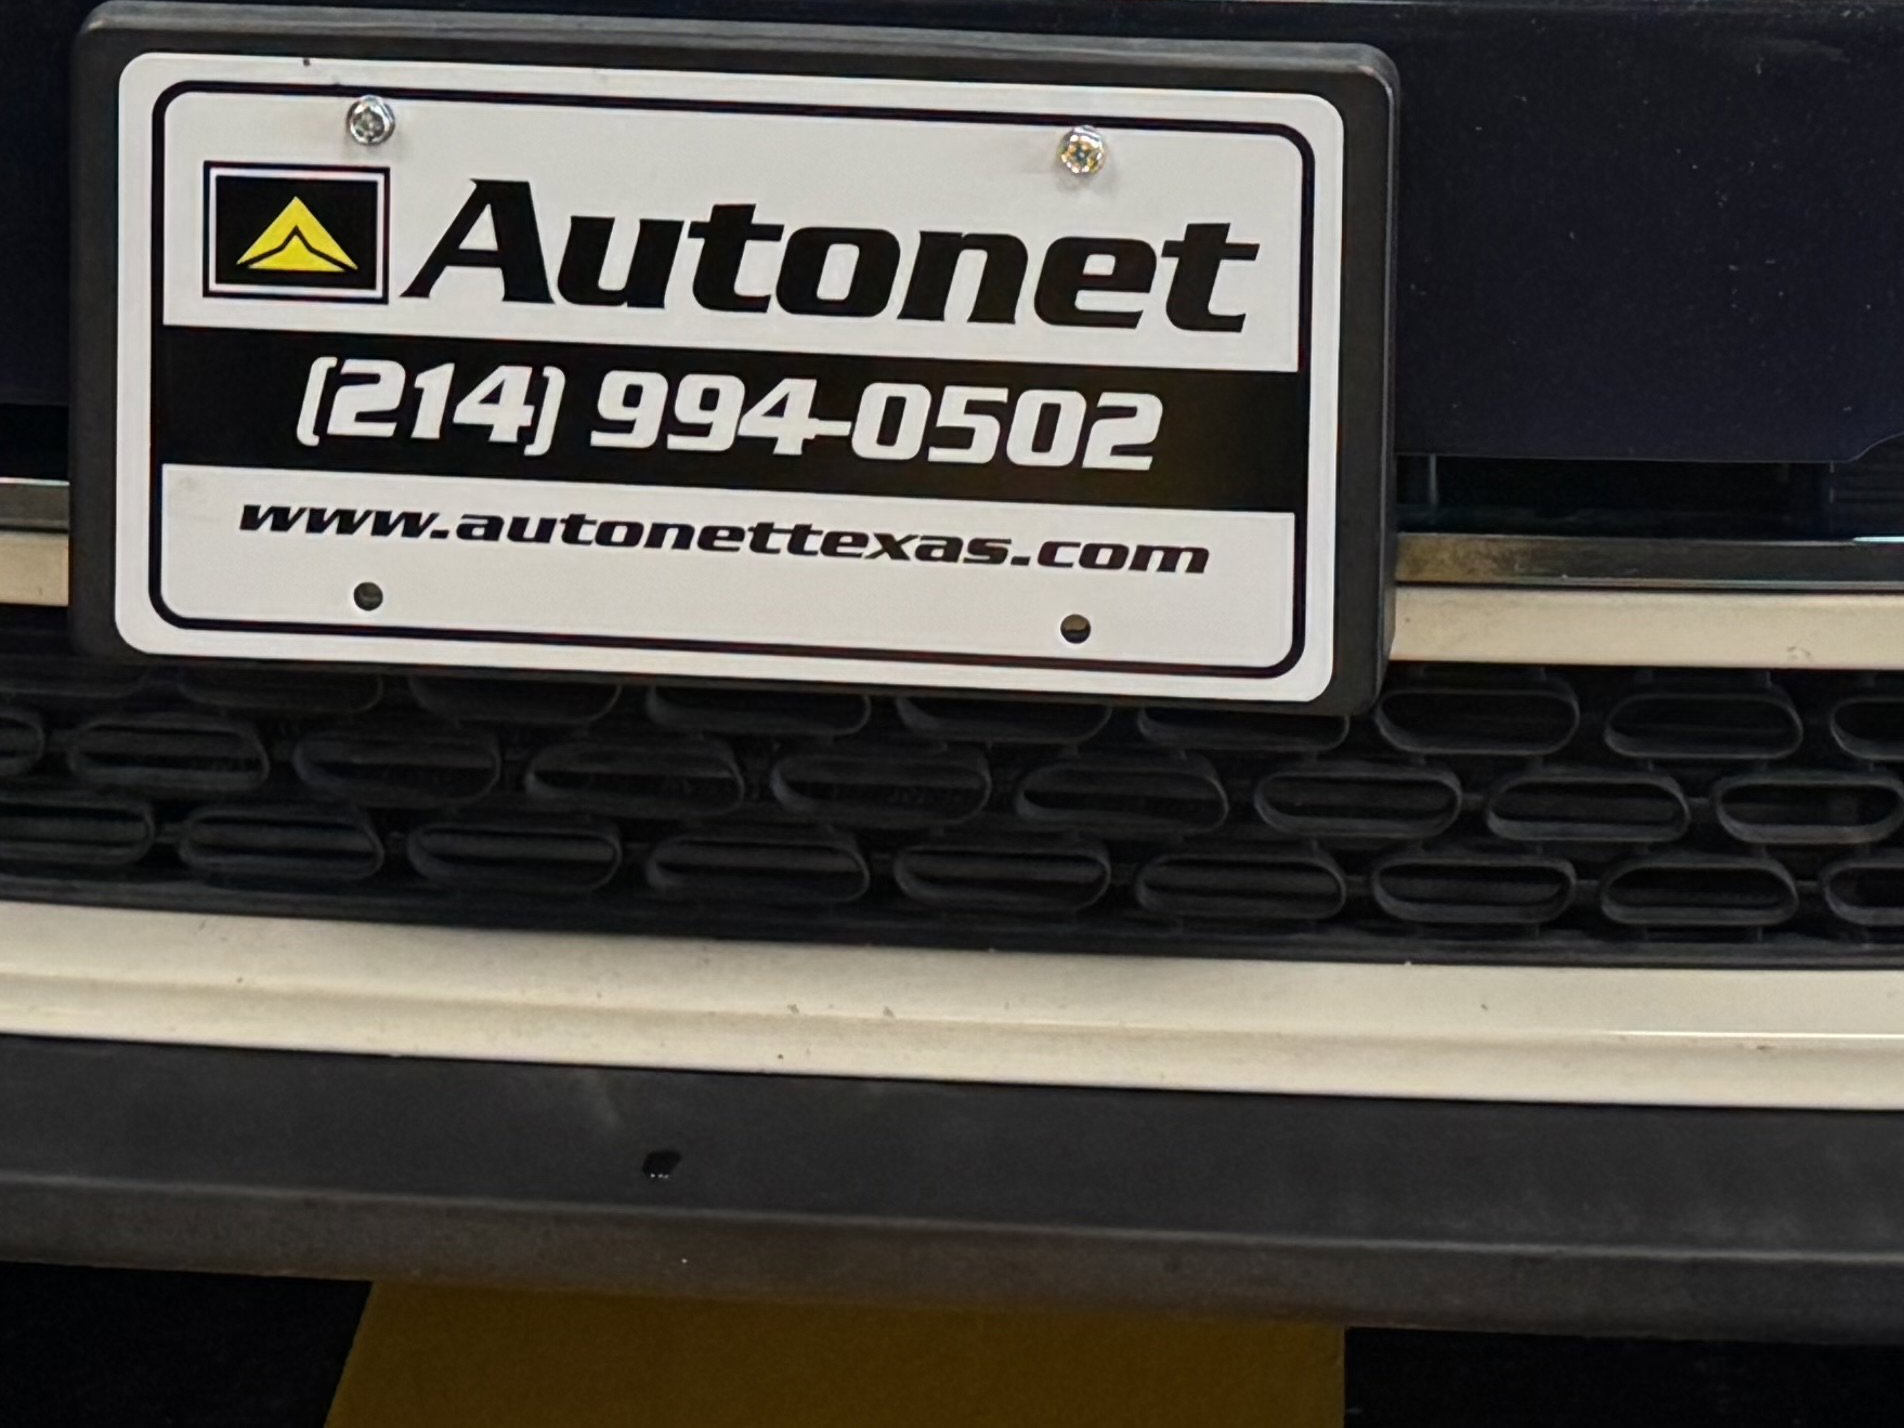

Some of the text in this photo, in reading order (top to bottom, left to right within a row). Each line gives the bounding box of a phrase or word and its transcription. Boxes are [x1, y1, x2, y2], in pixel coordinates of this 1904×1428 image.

[400, 178, 1261, 333] Autonet
[297, 356, 1164, 473] (214) 994-0502
[239, 501, 1210, 575] www.autonettexas.com
